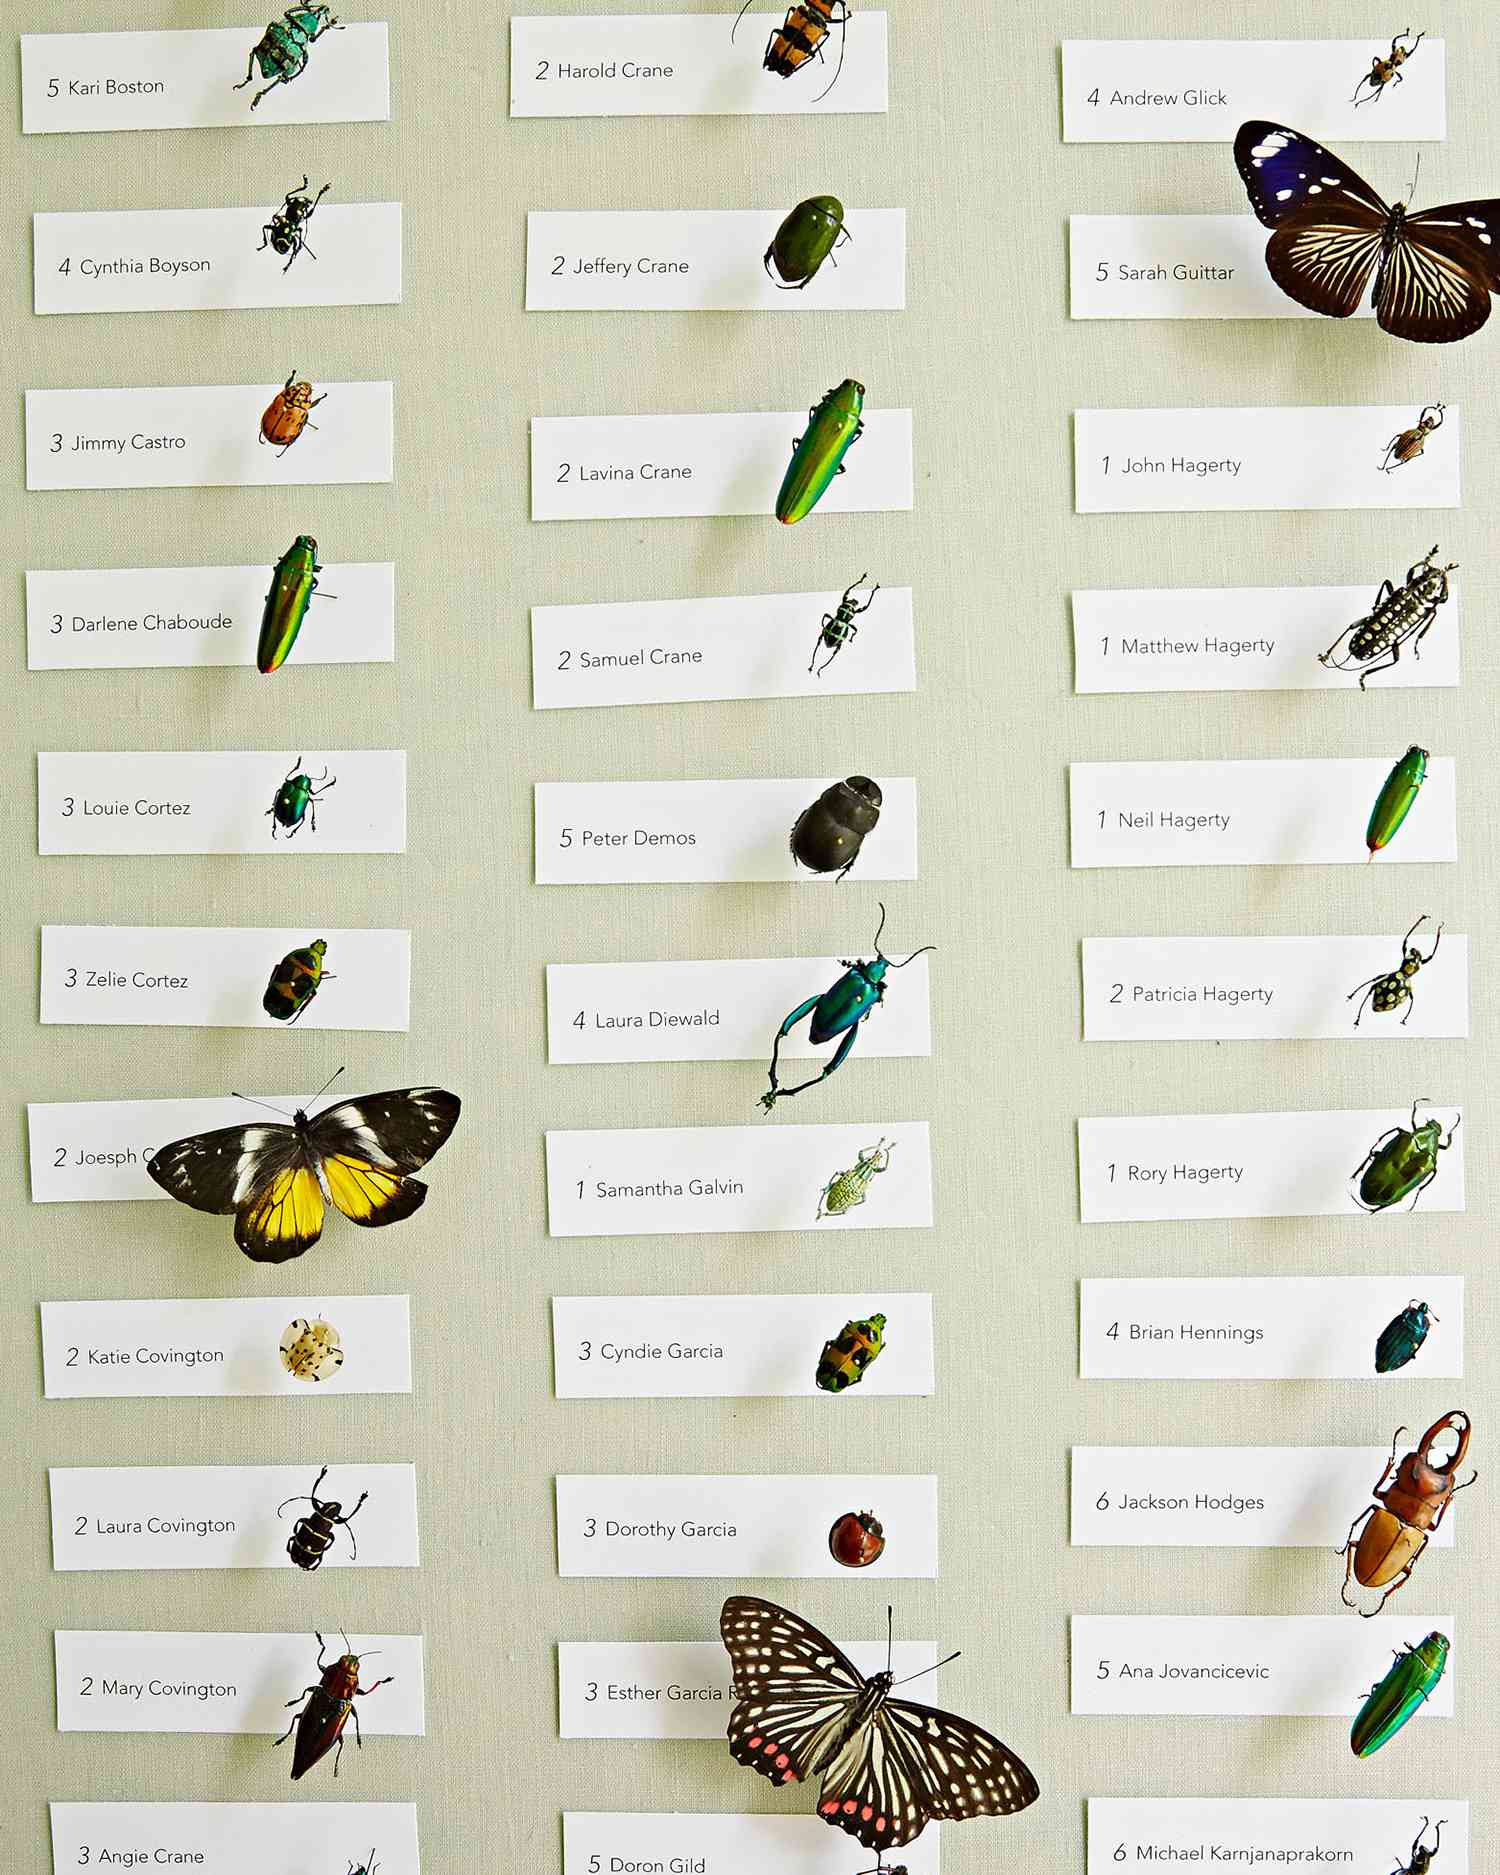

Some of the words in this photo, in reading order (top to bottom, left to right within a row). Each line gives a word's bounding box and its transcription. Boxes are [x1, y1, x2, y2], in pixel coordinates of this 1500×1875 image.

[536, 61, 549, 80] 2
[559, 62, 616, 78] Harold
[622, 62, 673, 78] Crane
[47, 79, 59, 97] 5
[69, 80, 99, 96] Kari
[106, 79, 164, 94] Boston
[1088, 88, 1100, 107] 4
[1110, 89, 1178, 105] Andrew
[1184, 89, 1227, 105] Glick
[59, 258, 71, 276] 4
[80, 258, 143, 279] Cynthia
[150, 258, 210, 276] Boyson
[552, 256, 565, 275] 2
[573, 257, 631, 278] Jeffery
[637, 258, 689, 273] Crane
[1096, 262, 1109, 281] 5
[1120, 264, 1166, 280] Sarah
[1173, 265, 1234, 280] Guittar
[50, 433, 62, 453] 3
[72, 436, 126, 454] Jimmy
[131, 434, 185, 449] Castro
[557, 463, 570, 482] 2
[581, 465, 634, 480] Lavina
[640, 464, 692, 479] Crane
[1102, 456, 1110, 475] 1
[1122, 456, 1164, 473] John
[1172, 457, 1241, 477] Hagerty
[50, 615, 62, 634] 3
[73, 616, 138, 632] Darlene
[143, 613, 232, 630] Chaboude
[1100, 637, 1109, 656] 1
[1123, 637, 1198, 654] Matthew
[1205, 637, 1275, 657] Hagerty
[558, 651, 571, 670] 2
[580, 649, 643, 668] Samuel
[650, 649, 702, 664] Crane
[62, 797, 74, 816] 3
[84, 800, 129, 815] Louie
[135, 800, 191, 815] Cortez
[1097, 810, 1106, 829] 1
[1120, 811, 1153, 828] Neil
[1161, 812, 1231, 832] Hagerty
[560, 829, 573, 848] 5
[583, 831, 628, 846] Peter
[635, 830, 696, 845] Demos
[65, 968, 77, 987] 3
[86, 971, 126, 987] Zelie
[133, 972, 188, 988] Cortez
[1110, 984, 1123, 1003] 2
[1134, 986, 1196, 1001] Patricia
[1204, 986, 1273, 1006] Hagerty
[573, 1011, 586, 1030] 4
[596, 1013, 643, 1028] Laura
[649, 1009, 719, 1027] Diewald
[54, 1148, 67, 1167] 2
[75, 1147, 136, 1168] Joesph
[1107, 1163, 1116, 1183] 1
[1129, 1165, 1167, 1184] Rory
[1174, 1164, 1243, 1184] Hagerty
[576, 1180, 584, 1199] 1
[597, 1180, 683, 1198] Samantha
[689, 1178, 743, 1195] Galvin
[1106, 1322, 1119, 1340] 4
[1130, 1324, 1173, 1339] Brian
[1181, 1324, 1263, 1344] Hennings
[66, 1347, 78, 1366] 2
[89, 1349, 130, 1364] Katie
[136, 1348, 223, 1367] Covington
[578, 1341, 591, 1360] 3
[601, 1344, 662, 1363] Cyndie
[667, 1343, 723, 1358] Garcia
[1096, 1491, 1109, 1510] 6
[1118, 1493, 1188, 1509] Jackson
[1196, 1493, 1264, 1514] Hodges
[75, 1517, 87, 1535] 2
[97, 1519, 141, 1534] Laura
[147, 1518, 235, 1536] Covington
[584, 1519, 596, 1537] 3
[606, 1521, 676, 1541] Dorothy
[681, 1521, 736, 1537] Garcia
[1097, 1661, 1111, 1679] 5
[1119, 1664, 1153, 1678] Ana
[1159, 1664, 1269, 1679] Jovancicevic
[80, 1677, 93, 1695] 2
[103, 1680, 143, 1699] Mary
[149, 1680, 236, 1700] Covington
[585, 1682, 597, 1701] 3
[608, 1684, 662, 1700] Esther
[667, 1685, 722, 1700] Garcia
[78, 1846, 89, 1865] 3
[99, 1849, 148, 1868] Angie
[154, 1849, 204, 1864] Crane
[588, 1855, 600, 1873] 5
[611, 1857, 663, 1872] Doron
[670, 1858, 705, 1873] Gild
[1113, 1843, 1127, 1861] 6
[1137, 1845, 1204, 1860] Michael
[1211, 1845, 1353, 1865] Karnjanaprakorn
